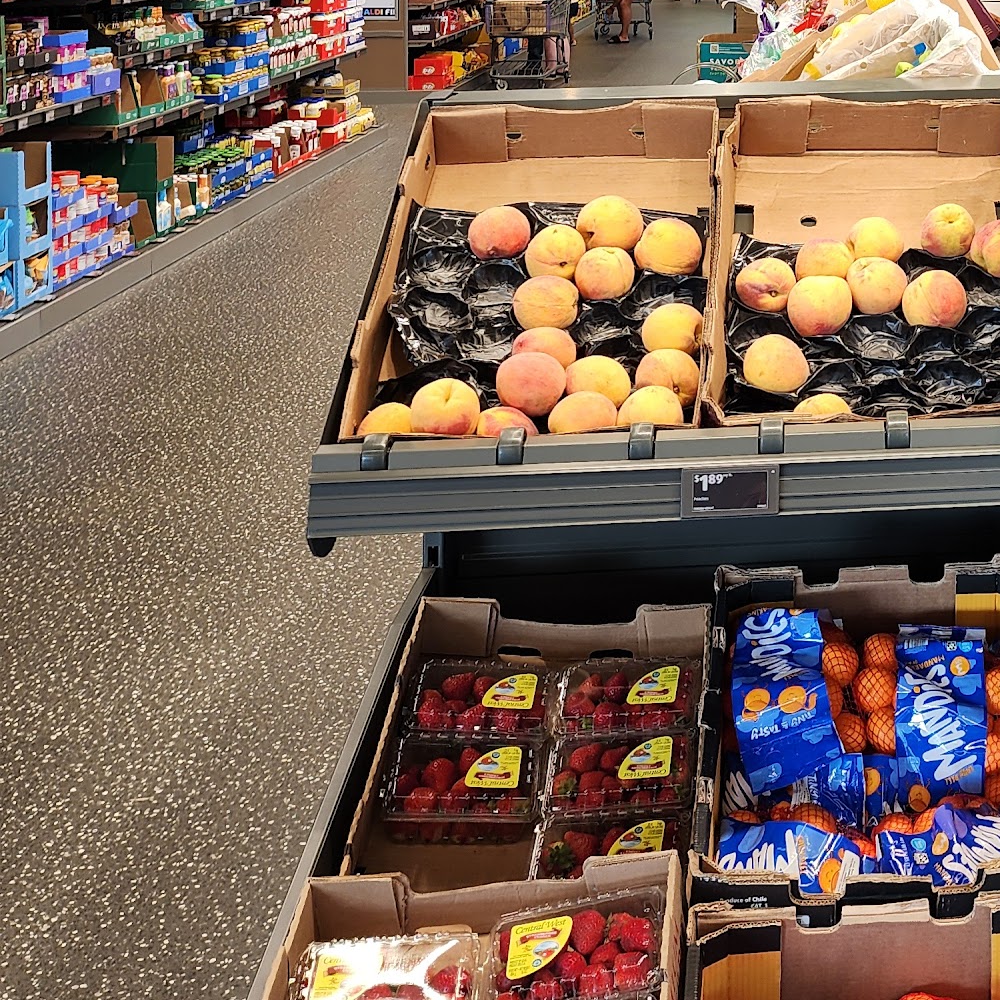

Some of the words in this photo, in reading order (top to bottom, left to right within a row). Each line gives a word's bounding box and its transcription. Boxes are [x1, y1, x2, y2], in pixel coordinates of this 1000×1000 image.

[363, 8, 384, 16] ALDI
[790, 710, 816, 727] TINY
[750, 724, 782, 740] TASTY
[515, 921, 546, 935] Central
